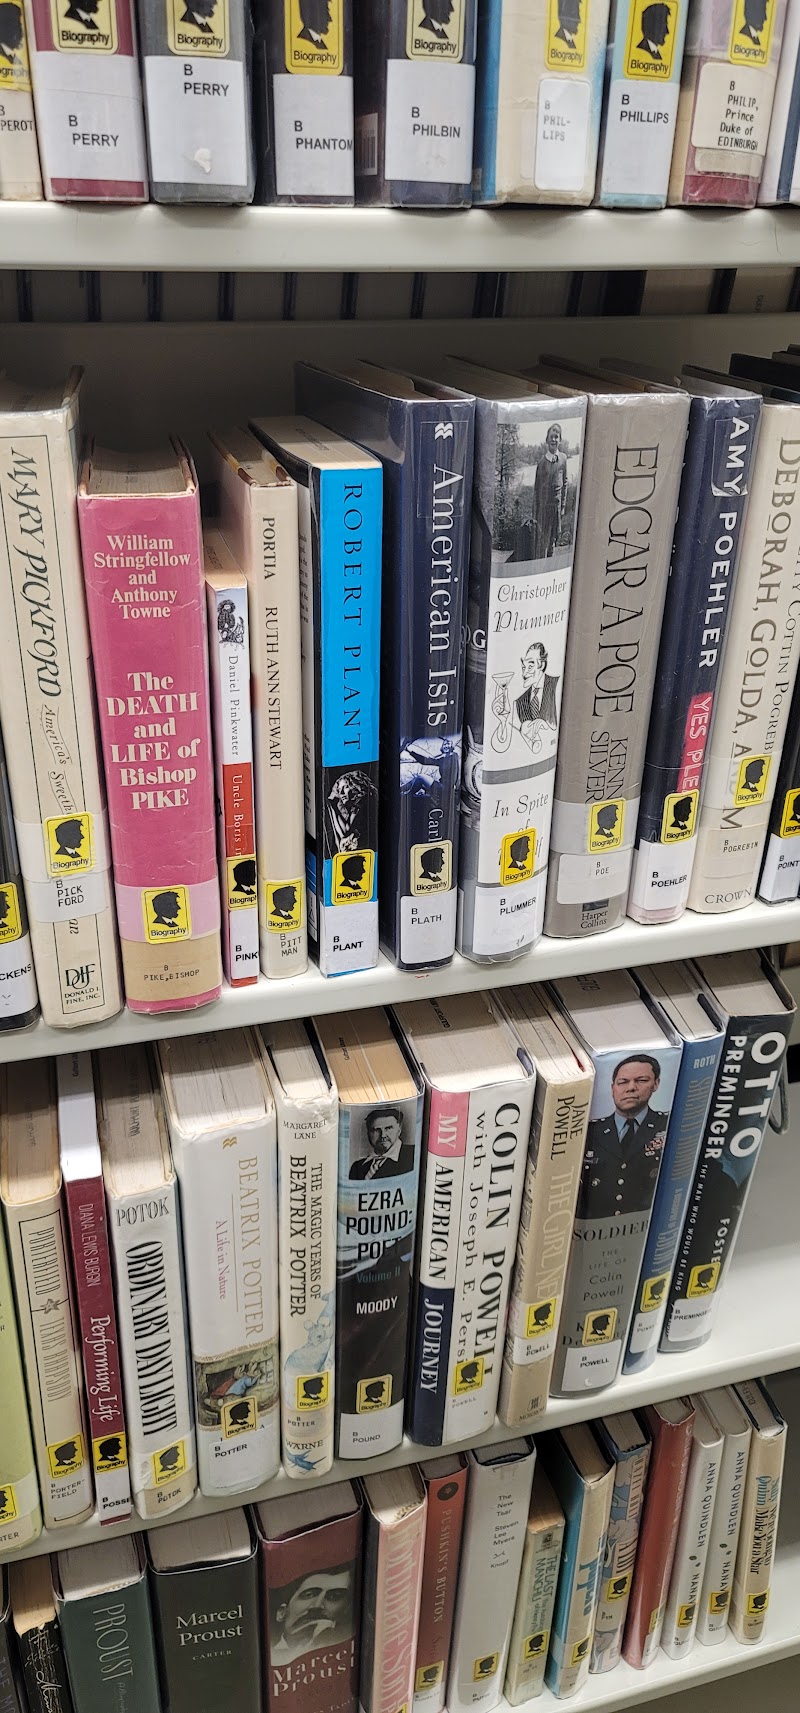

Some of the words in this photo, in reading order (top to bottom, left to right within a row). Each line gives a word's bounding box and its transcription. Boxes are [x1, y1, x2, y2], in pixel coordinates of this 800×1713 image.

[61, 29, 110, 46] Biography
[177, 33, 223, 49] Biography
[414, 38, 457, 53] Biography
[293, 51, 337, 65] Biography
[550, 48, 582, 64] Biography
[734, 44, 766, 60] Biography
[184, 64, 193, 76] B
[630, 60, 669, 74] Biography
[183, 82, 229, 97] PERRY
[729, 81, 736, 91] B
[621, 95, 630, 105] B
[727, 95, 759, 111] PHILIP,
[69, 115, 78, 127] B
[411, 107, 420, 118] B
[543, 115, 571, 127] PHIL-
[620, 111, 669, 124] PHILLIPS
[725, 109, 755, 123] Prince
[0, 120, 33, 132] PEROT
[295, 121, 303, 132] B
[412, 124, 461, 138] PHILBIN
[720, 122, 742, 135] Duke
[745, 126, 754, 136] of
[72, 133, 119, 147] PERRY
[296, 138, 353, 151] PHANTOM
[542, 131, 565, 142] LIPS
[717, 136, 759, 151] EDINBURGH
[723, 416, 750, 495] AMY
[8, 447, 45, 548] MARY
[603, 442, 660, 595] EDGAR
[751, 436, 800, 612] DEBORAH,
[107, 535, 174, 551] William
[262, 516, 277, 580] PORTIA
[93, 552, 191, 570] Stringfellow
[343, 482, 363, 627] ROBERT
[427, 463, 464, 656] American
[128, 570, 157, 586] and
[111, 586, 178, 605] Anthony
[497, 577, 567, 603] Christopher
[698, 511, 738, 669] POEHLER
[13, 544, 62, 697] PICKFORD
[118, 604, 171, 620] Towne
[492, 608, 567, 633] Plummer
[599, 601, 644, 636] A.
[265, 606, 279, 655] RUTH
[127, 672, 174, 692] The
[228, 655, 240, 694] Daniel
[266, 657, 281, 697] ANN
[592, 641, 641, 718] POE
[731, 619, 777, 734] GOLDA,
[106, 691, 199, 717] DEATH
[343, 645, 363, 751] PLANT
[425, 665, 457, 728] Isis
[133, 717, 177, 739] and
[230, 699, 242, 757] Pinkwater
[689, 696, 712, 740] YES
[43, 705, 67, 766] America's
[268, 696, 283, 771] STEWART
[110, 742, 171, 764] LIFE
[177, 738, 201, 758] of
[120, 765, 197, 787] Bishop
[584, 730, 610, 803] SILVER
[131, 789, 189, 811] PIKE
[232, 774, 243, 810] Uncle
[737, 792, 763, 802] Biography
[492, 799, 510, 819] In
[516, 792, 549, 815] Spite
[233, 813, 244, 844] Boris
[428, 807, 445, 844] Carl
[667, 829, 692, 840] Biography
[592, 837, 620, 848] Biography
[723, 840, 759, 853] POGREBIN
[53, 857, 90, 870] Biography
[505, 869, 532, 881] Biography
[651, 874, 687, 888] POEHLER
[58, 885, 83, 897] PICK
[337, 889, 367, 899] Biography
[416, 881, 448, 892] Biography
[705, 887, 752, 905] CROWN
[58, 895, 84, 908] FORD
[500, 896, 537, 915] PLUMMER
[268, 919, 299, 929] Biography
[411, 914, 442, 925] PLATH
[580, 917, 608, 929] Collins
[581, 910, 608, 921] Harper
[151, 925, 187, 938] Biography
[280, 936, 302, 948] PITT
[281, 947, 298, 957] MAN
[333, 941, 364, 952] PLANT
[143, 969, 200, 982] PIKE,BISHOP
[65, 988, 92, 999] DONALD
[693, 1054, 716, 1069] ROTH
[704, 1035, 748, 1159] PREMINGER
[730, 1031, 787, 1158] OTTO
[283, 1118, 327, 1130] MARGARET
[551, 1094, 576, 1161] POWELL
[569, 1101, 589, 1140] JANE
[294, 1131, 316, 1140] LANE
[438, 1113, 459, 1150] MY
[471, 1110, 488, 1170] with
[485, 1102, 521, 1231] COLIN
[310, 1163, 323, 1192] THE
[238, 1155, 262, 1251] BEATRIX
[290, 1155, 307, 1239] BEATRIX
[358, 1187, 404, 1212] EZRA
[78, 1203, 95, 1231] DIANA
[115, 1196, 169, 1226] POTOK
[310, 1195, 323, 1240] MAGIC
[428, 1161, 455, 1281] AMERICAN
[689, 1204, 700, 1224] WHO
[346, 1209, 413, 1236] POUND:
[462, 1182, 484, 1269] Joseph
[216, 1231, 231, 1251] Life
[683, 1228, 695, 1256] WOULD
[310, 1241, 323, 1283] YEARS
[216, 1265, 230, 1300] Nature
[290, 1247, 307, 1317] POTTER
[588, 1271, 622, 1286] Colin
[125, 1240, 172, 1340] ORDINARY
[242, 1258, 264, 1337] POTTER
[310, 1285, 321, 1299] OF
[461, 1277, 476, 1301] E.
[583, 1286, 624, 1301] Powell
[356, 1296, 398, 1315] MOODY
[85, 1315, 115, 1395] Performing
[420, 1298, 445, 1395] JOURNEY
[580, 1357, 610, 1369] POWELL
[135, 1339, 178, 1436] DAYLIGHT
[91, 1394, 121, 1423] Life
[227, 1421, 254, 1437] Biography
[352, 1434, 381, 1443] POUND
[215, 1443, 248, 1458] POTTER
[286, 1439, 324, 1451] WARNE
[96, 1458, 127, 1472] Biography
[733, 1451, 745, 1482] ANNA
[51, 1479, 85, 1495] PORTER-
[707, 1462, 717, 1493] ANNA
[51, 1489, 77, 1500] FIELD
[498, 1493, 512, 1501] The
[727, 1483, 742, 1536] QUINDLEN
[494, 1521, 519, 1532] Steven
[697, 1494, 713, 1548] QUINDLEN
[436, 1509, 453, 1574] PUSHKIN'S
[543, 1575, 556, 1597] LAST
[432, 1573, 448, 1624] BUTTON
[176, 1604, 243, 1630] Marcel
[93, 1603, 134, 1681] PROUST
[179, 1624, 242, 1647] Proust
[192, 1649, 232, 1661] CARTER
[273, 1640, 355, 1683] Marcel
[273, 1655, 354, 1697] Proust
